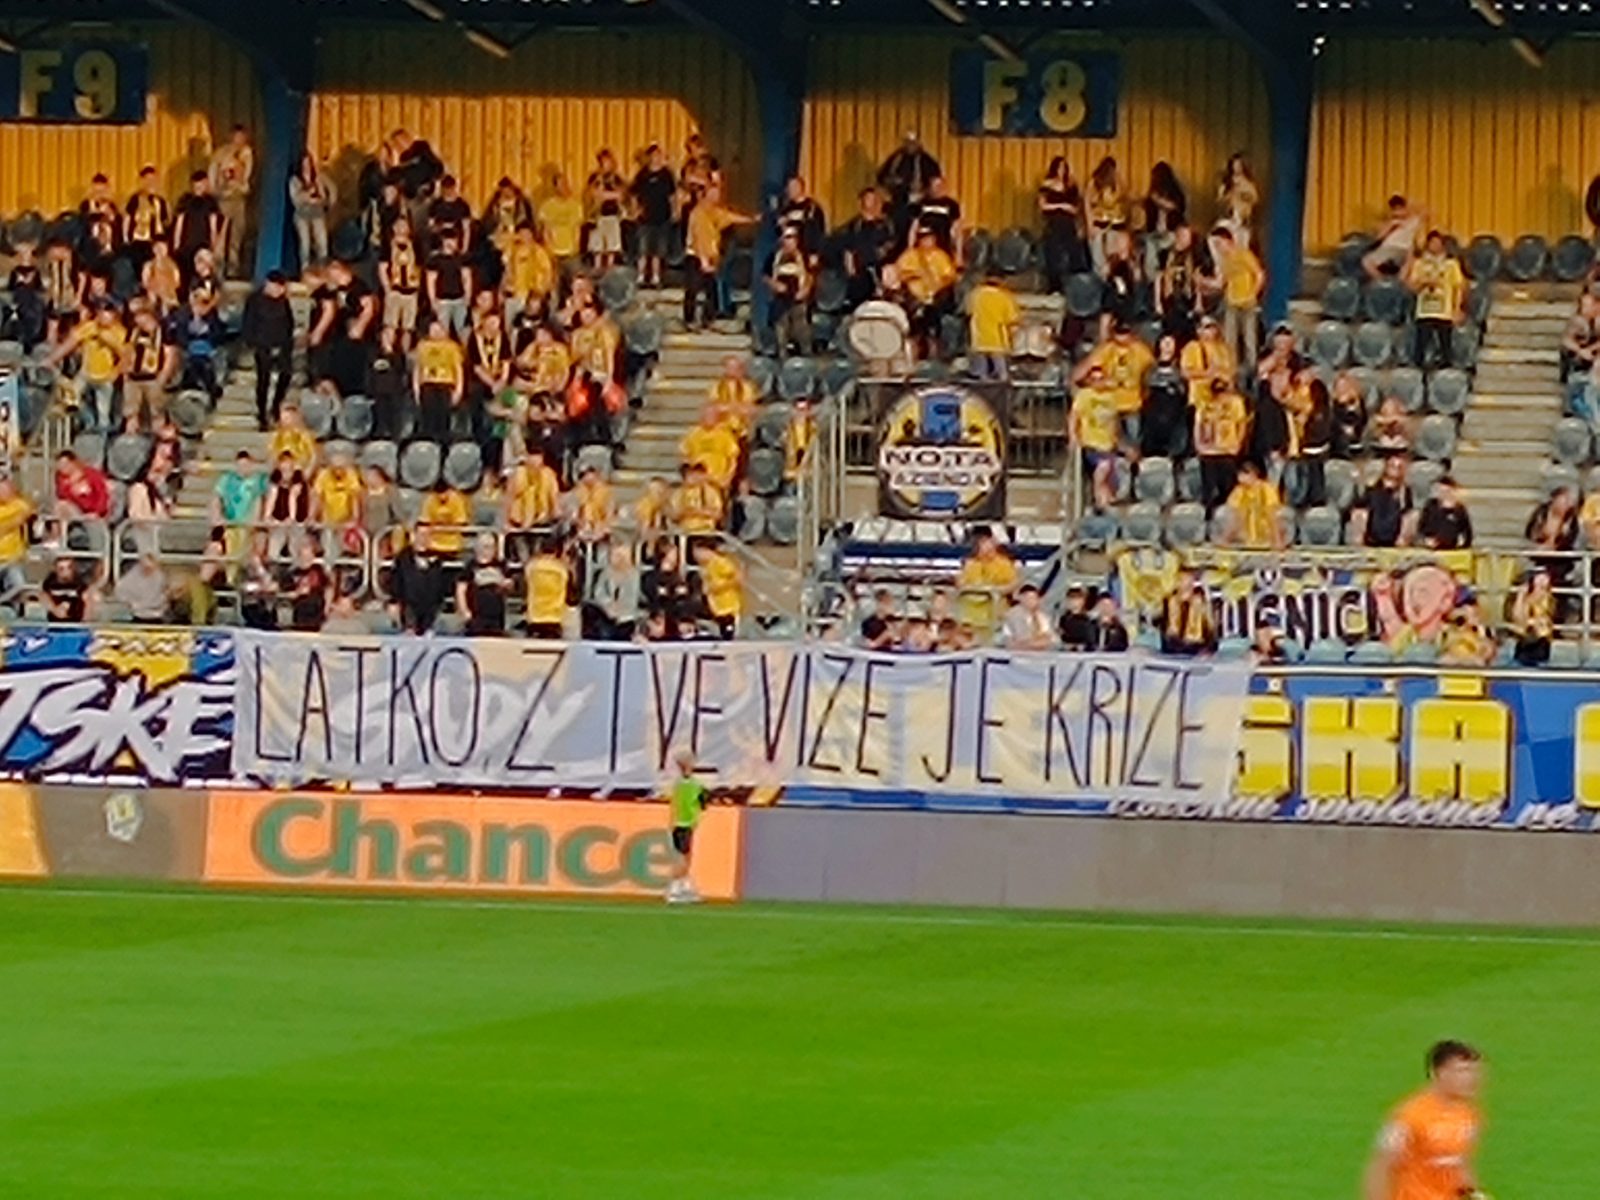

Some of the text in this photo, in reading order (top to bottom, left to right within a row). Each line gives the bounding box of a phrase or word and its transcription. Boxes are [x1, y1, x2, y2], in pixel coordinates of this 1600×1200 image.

[505, 648, 569, 771] Z
[760, 653, 895, 776] VIZE
[921, 657, 1011, 784] JE
[1043, 661, 1213, 790] KRIZE
[249, 797, 679, 891] Chance
